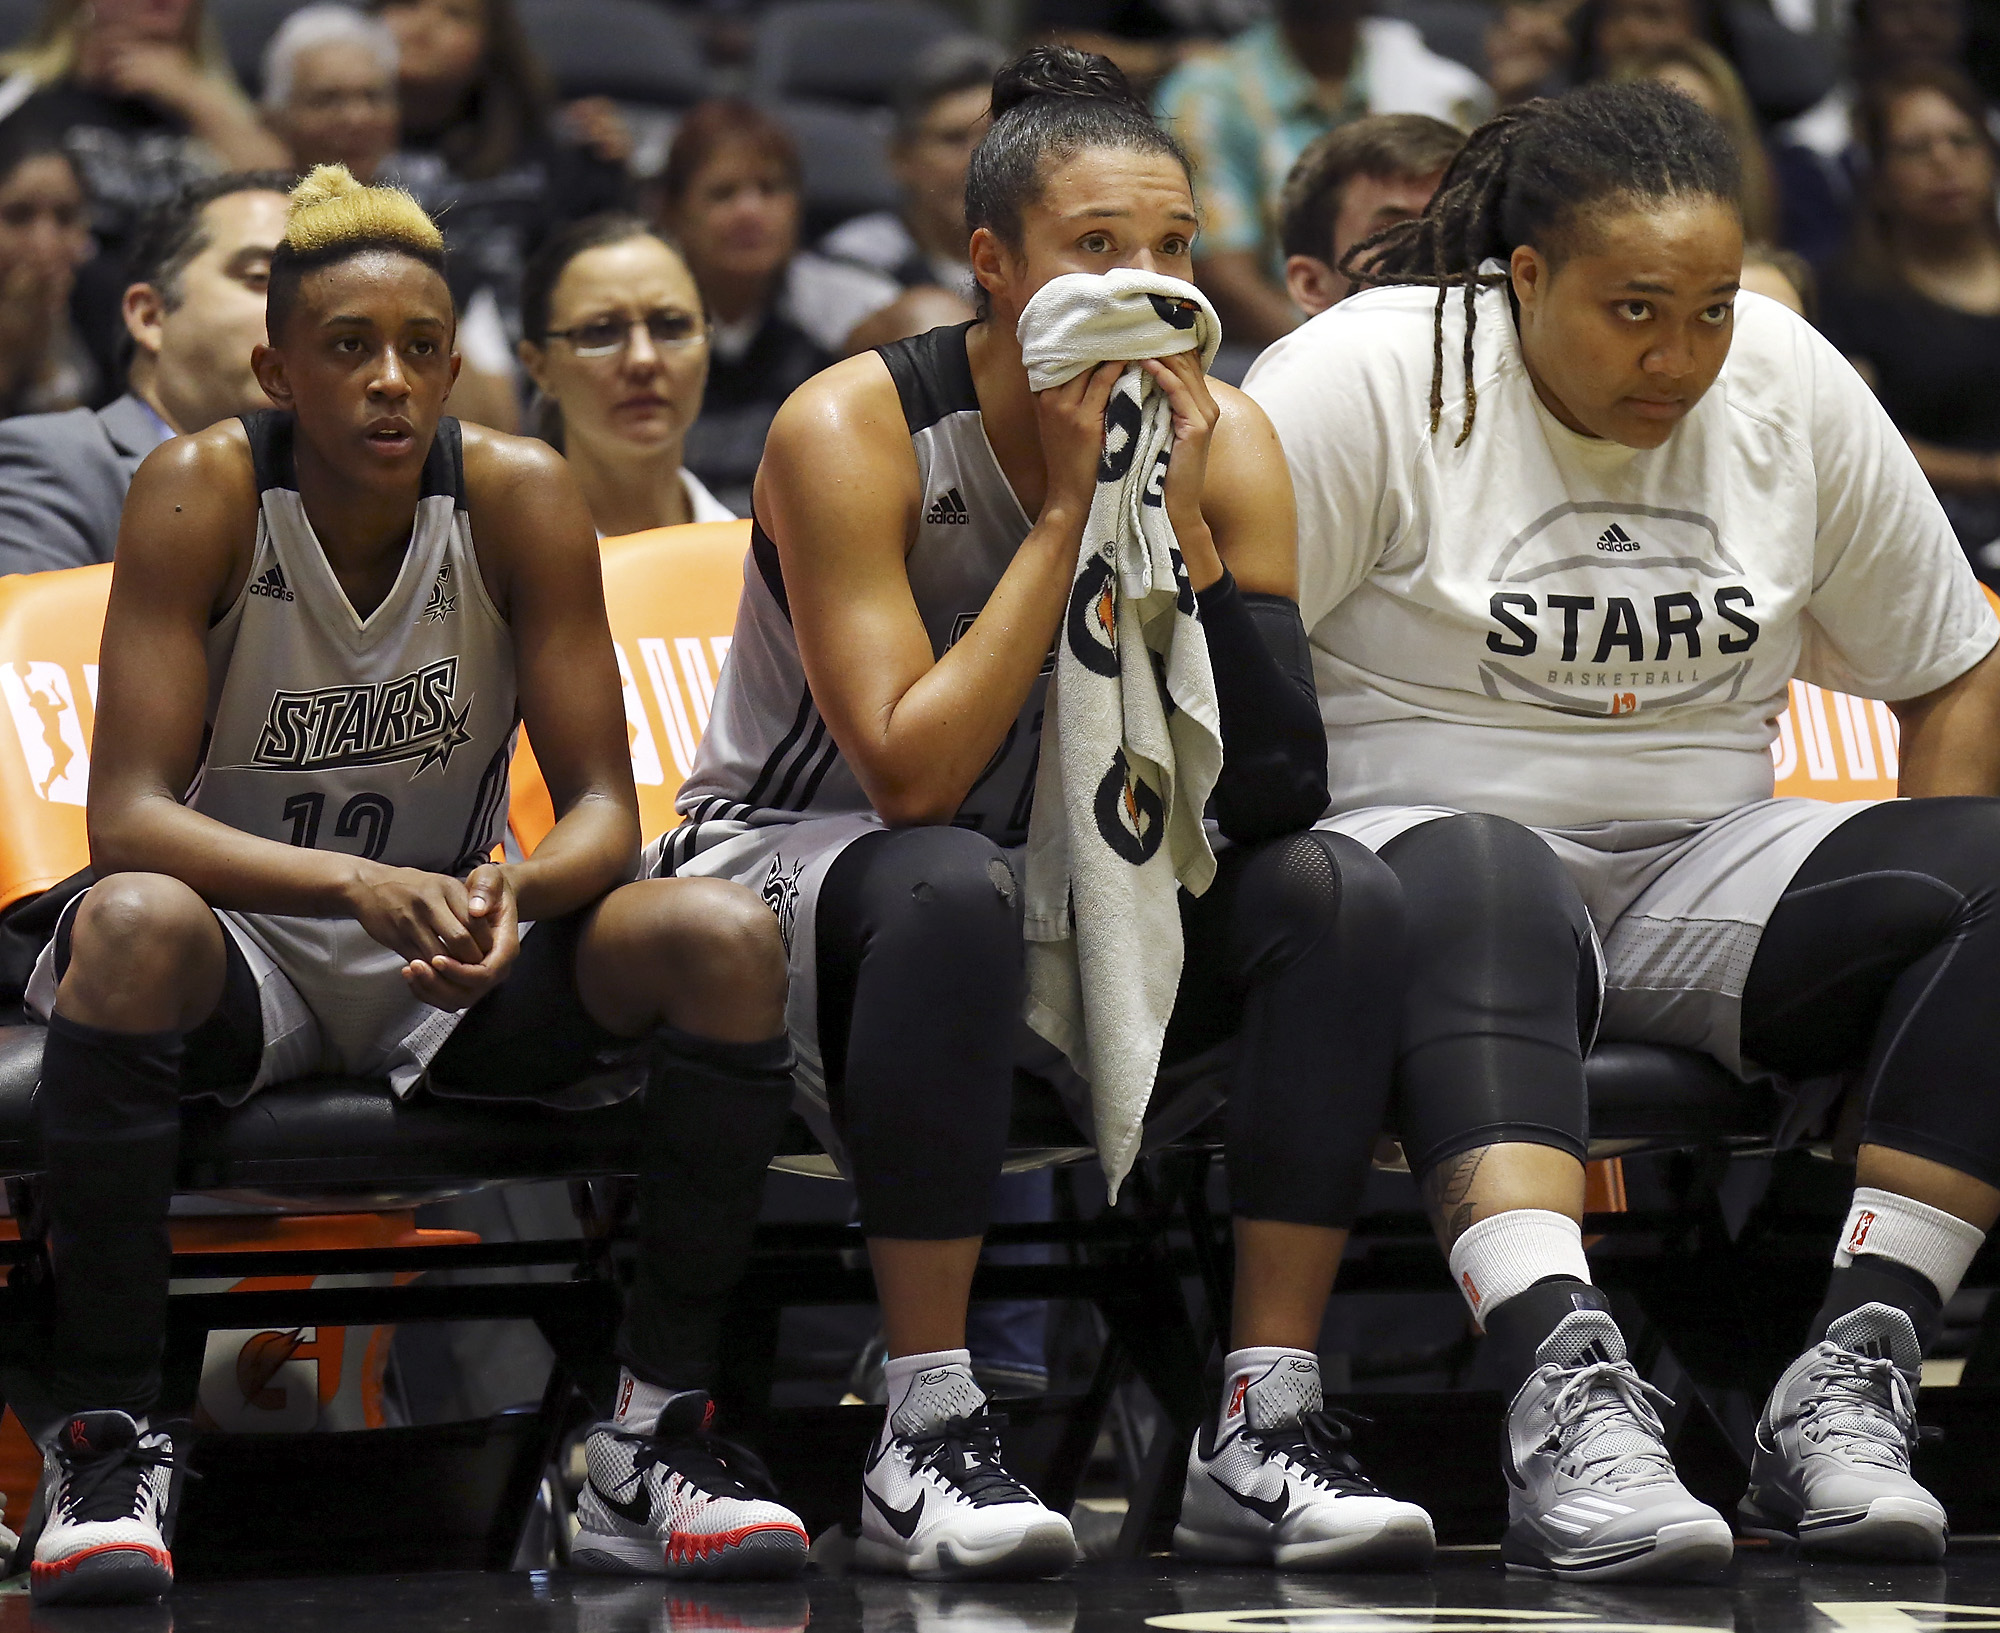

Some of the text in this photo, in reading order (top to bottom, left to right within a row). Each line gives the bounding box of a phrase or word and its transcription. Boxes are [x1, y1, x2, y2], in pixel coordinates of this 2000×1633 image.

[1596, 540, 1641, 553] adidas
[1486, 586, 1760, 663] STARS
[1547, 669, 1700, 686] BASKETBALL
[251, 655, 460, 766] STARS
